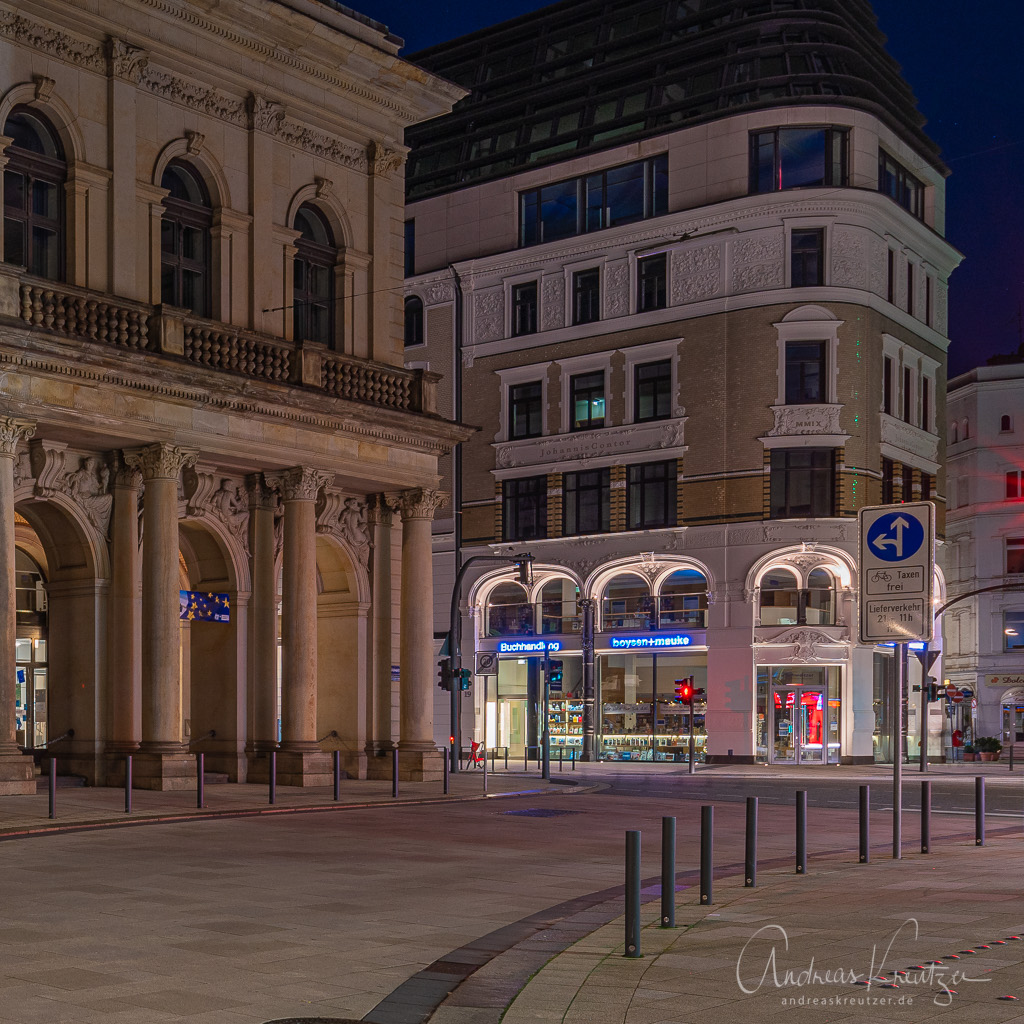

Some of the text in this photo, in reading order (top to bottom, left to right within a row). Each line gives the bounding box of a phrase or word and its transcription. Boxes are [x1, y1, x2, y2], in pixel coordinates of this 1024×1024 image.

[540, 439, 631, 457] JohannisContor
[897, 571, 920, 579] Taxen
[887, 582, 904, 591] frei
[869, 603, 922, 613] Lieferverkehr
[612, 635, 690, 649] boysen+mauke
[1002, 675, 1024, 684] Dolc
